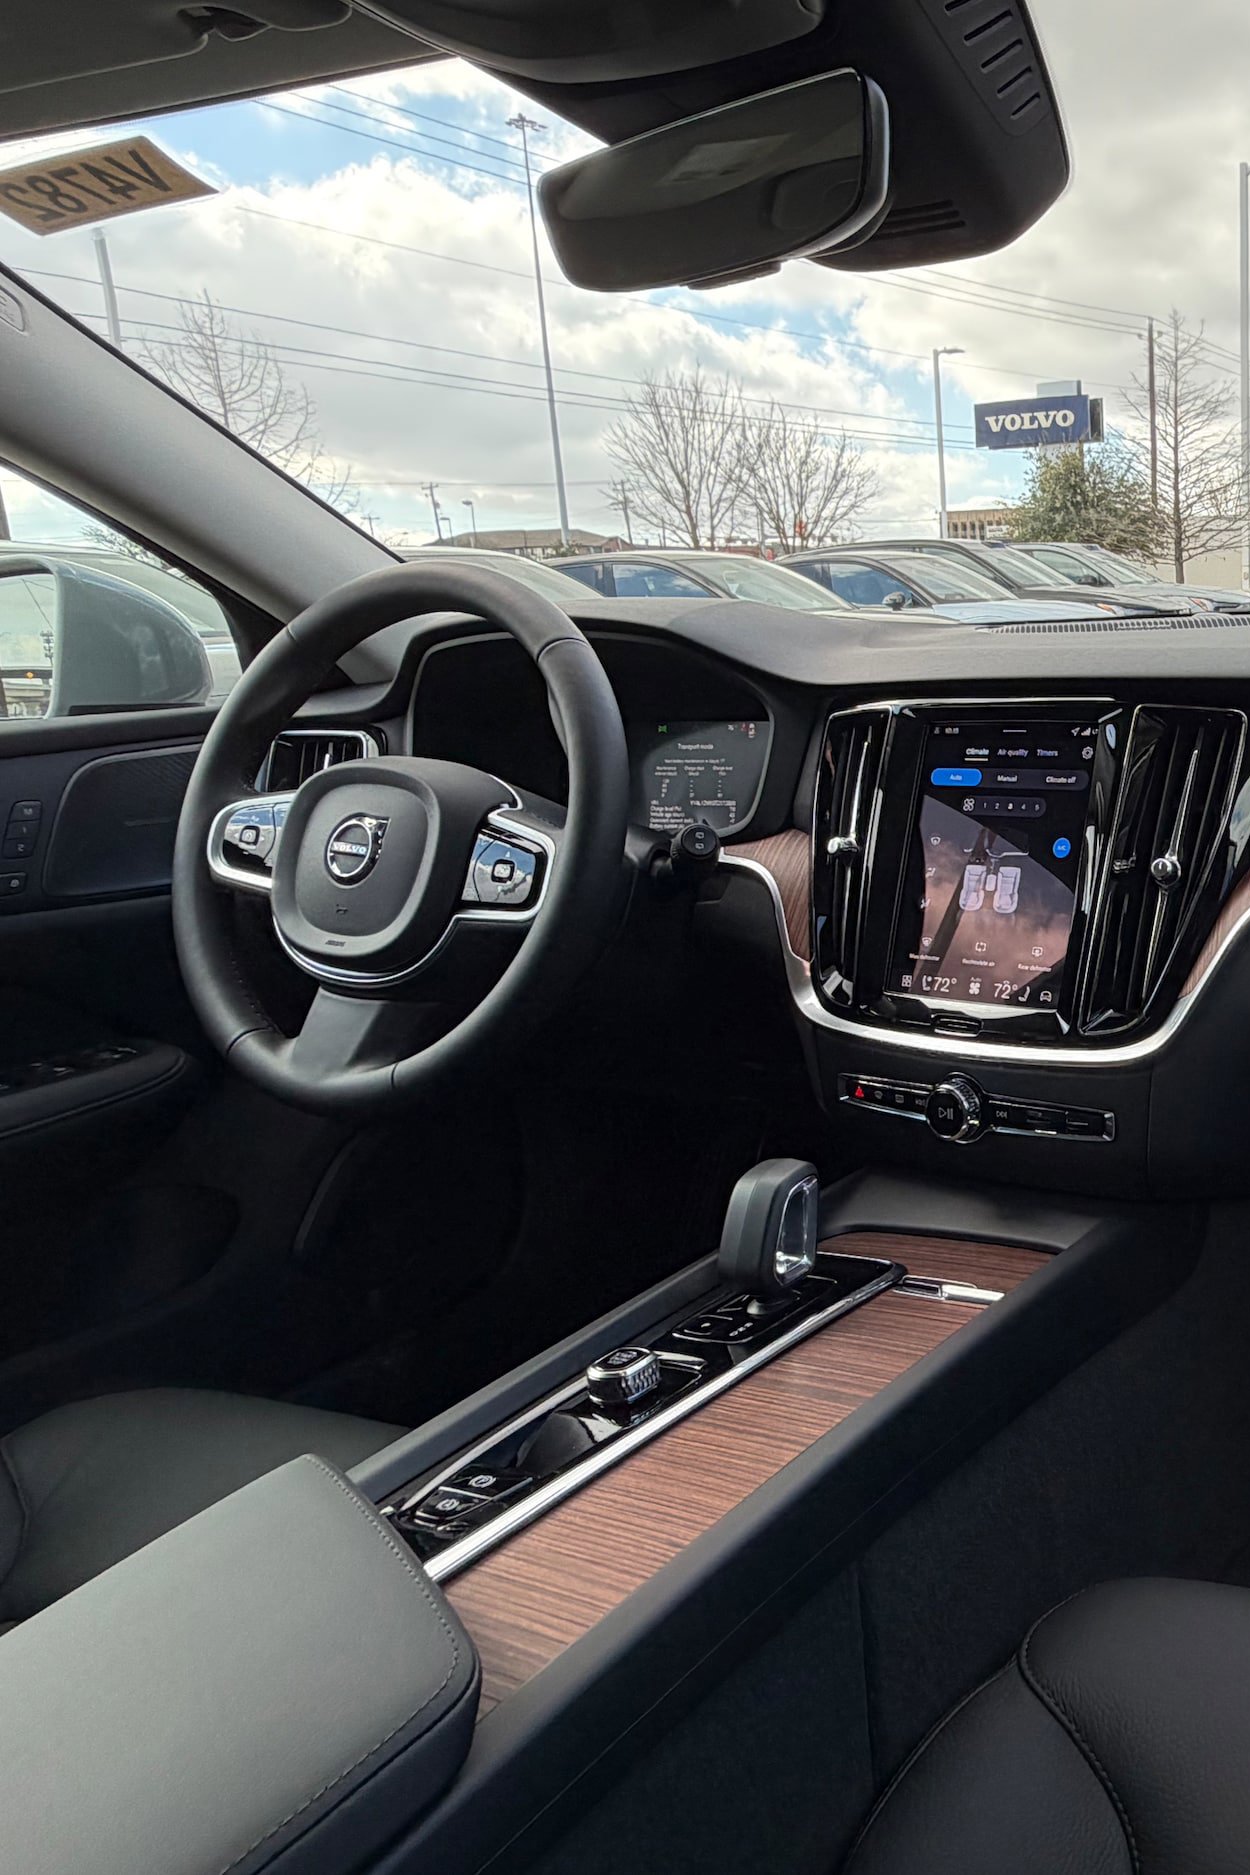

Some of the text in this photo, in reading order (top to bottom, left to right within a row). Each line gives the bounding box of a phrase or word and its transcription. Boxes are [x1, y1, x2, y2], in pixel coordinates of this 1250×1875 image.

[985, 409, 1075, 433] VOLVO
[966, 748, 990, 756] Climate
[1008, 748, 1028, 758] quality
[997, 774, 1018, 782] Manual
[1068, 776, 1076, 784] off
[332, 842, 367, 854] VOLVO
[933, 976, 958, 992] 72°
[994, 983, 1018, 1000] 72°
